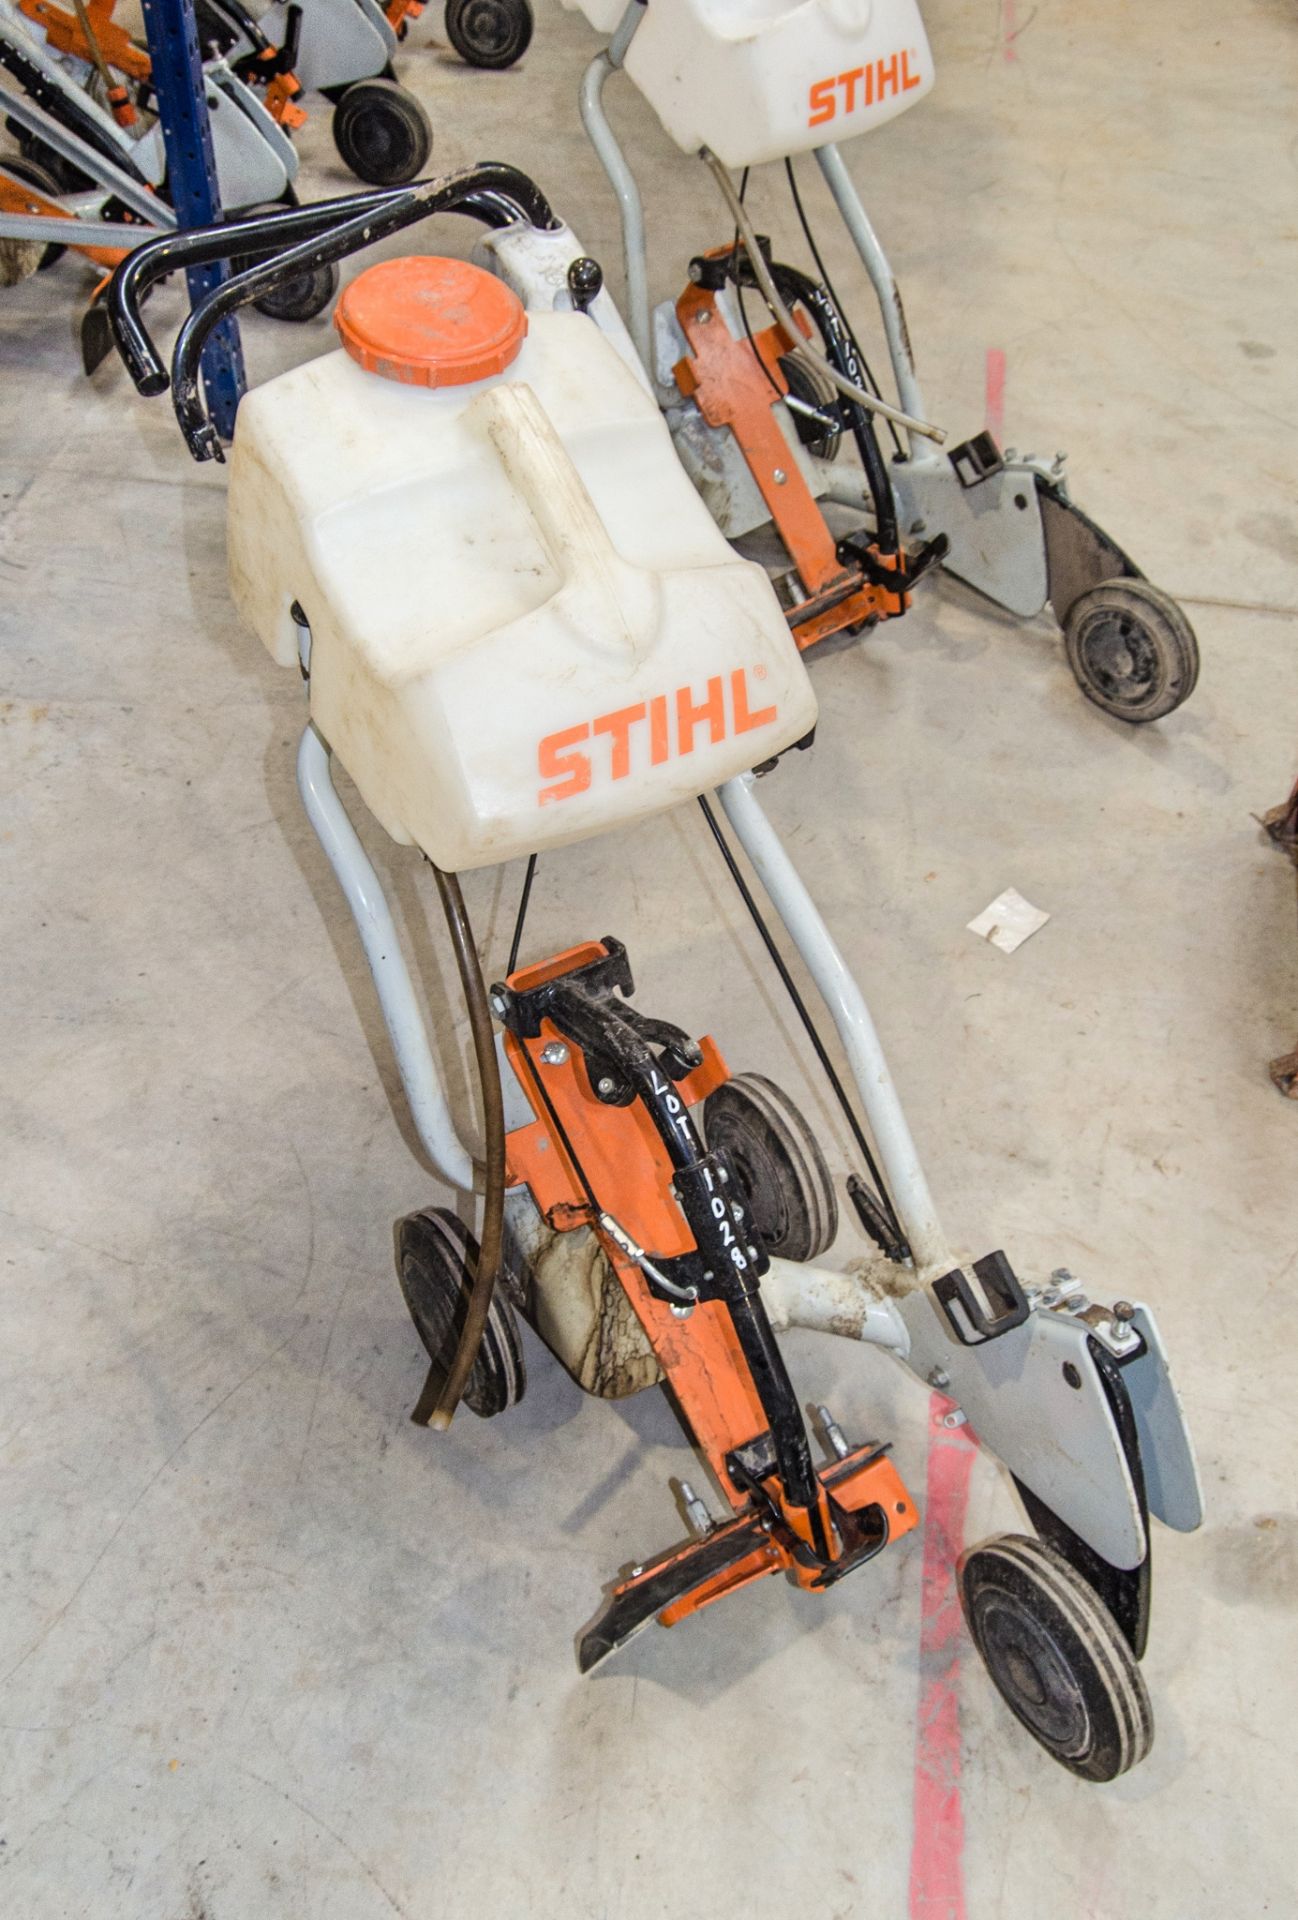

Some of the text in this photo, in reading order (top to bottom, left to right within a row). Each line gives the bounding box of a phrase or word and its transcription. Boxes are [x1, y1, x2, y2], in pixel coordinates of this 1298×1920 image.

[808, 48, 919, 128] STIHL
[816, 290, 839, 333] LOT
[537, 665, 777, 808] STIHL
[650, 1069, 747, 1271] LOT 1028
